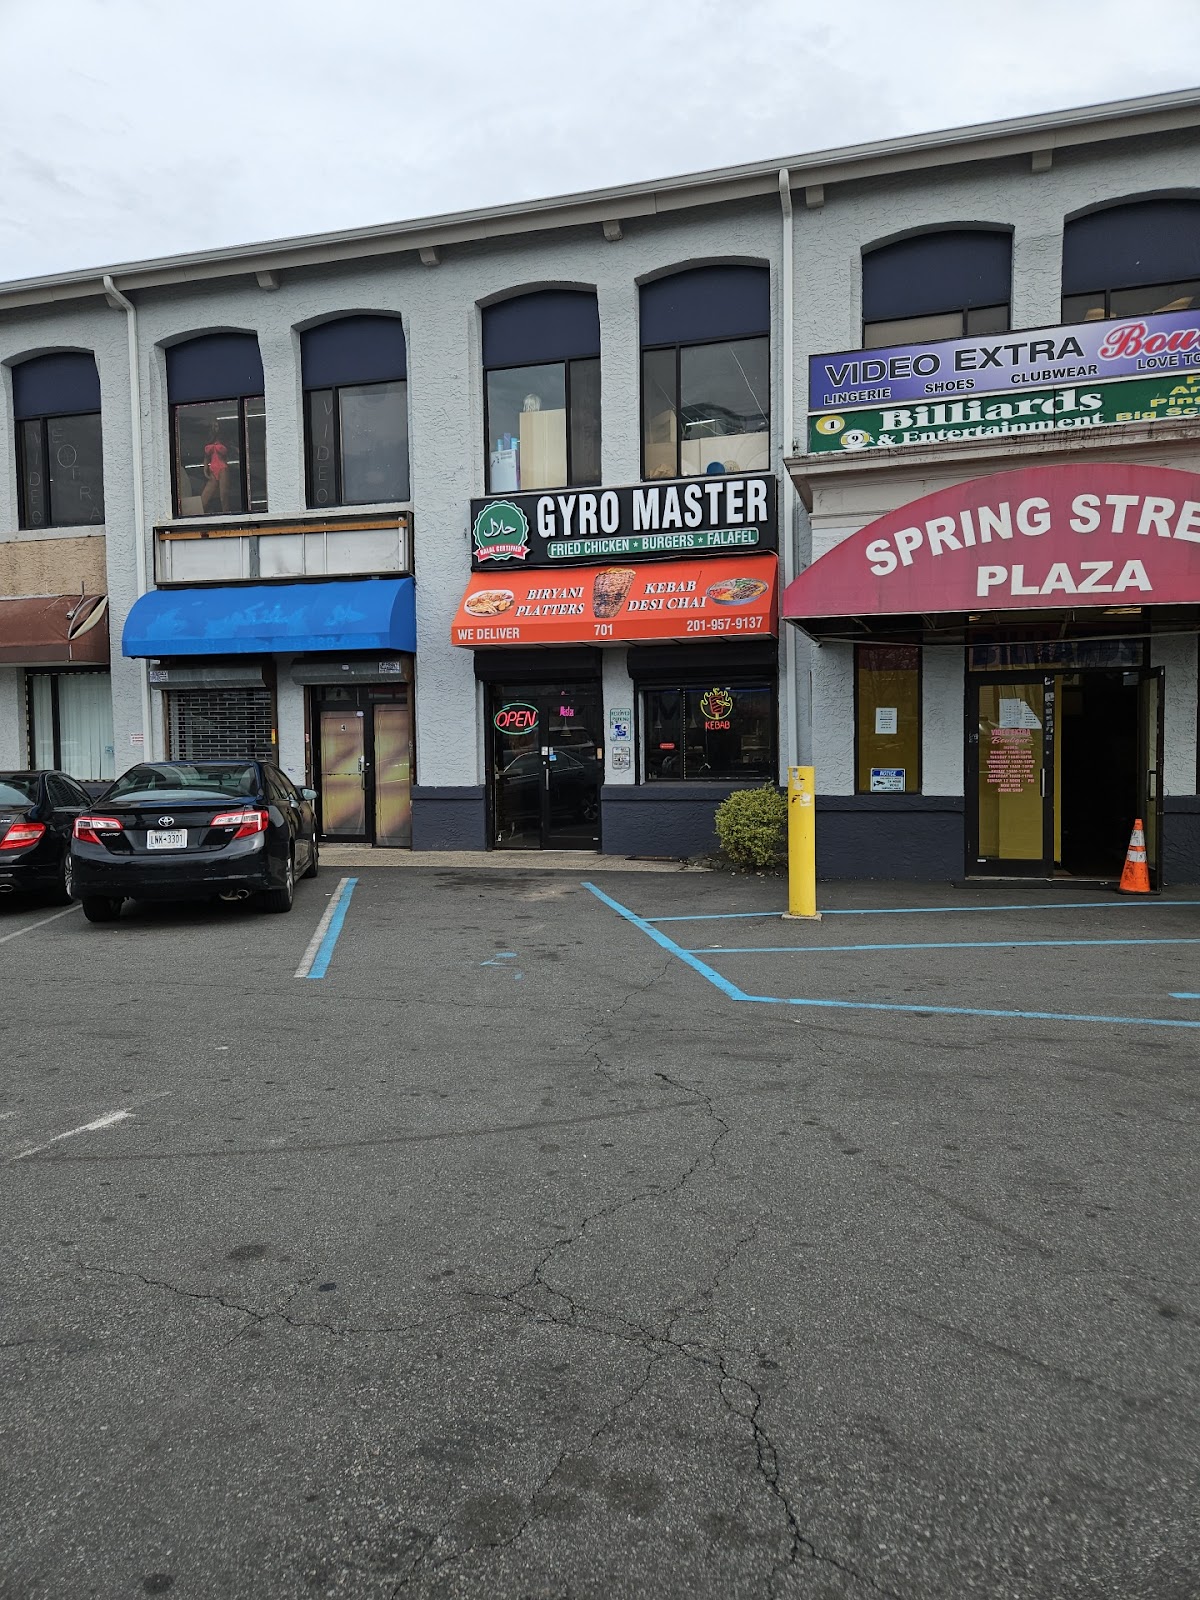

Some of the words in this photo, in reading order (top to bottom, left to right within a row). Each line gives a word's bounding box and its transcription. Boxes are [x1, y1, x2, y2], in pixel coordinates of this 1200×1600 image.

[1099, 321, 1200, 360] Bou
[825, 353, 941, 387] VIDEO
[953, 336, 1085, 373] EXTRA
[1137, 356, 1178, 370] LOVE
[823, 387, 891, 406] LINGERIE
[924, 378, 975, 394] SHOES
[1010, 364, 1098, 385] CLUBWEAR
[879, 389, 1104, 433] Billiards
[1116, 410, 1157, 422] Big
[1165, 407, 1200, 417] Sc
[877, 432, 898, 446] &
[901, 413, 1105, 445] Entertainment
[536, 490, 619, 539] GYRO
[632, 479, 769, 531] MASTER
[483, 517, 517, 538] حلال
[865, 496, 1052, 577] SPRING
[1069, 493, 1200, 544] STRE
[550, 541, 581, 556] FRIED
[583, 538, 630, 554] CHICKEN
[642, 533, 694, 549] BURGERS
[706, 529, 755, 545] FALAFEL
[526, 586, 585, 601] BIRYANI
[644, 580, 697, 595] KEBAB
[976, 559, 1153, 597] PLAZA
[515, 602, 585, 617] PLATTERS
[627, 598, 664, 612] DESI
[667, 595, 707, 610] CHAI
[457, 628, 475, 640] WE
[477, 627, 520, 640] DELIVER
[594, 624, 613, 636] 701
[686, 616, 763, 633] 201-957-9137
[496, 710, 537, 728] OPEN
[704, 721, 731, 730] KEBAB
